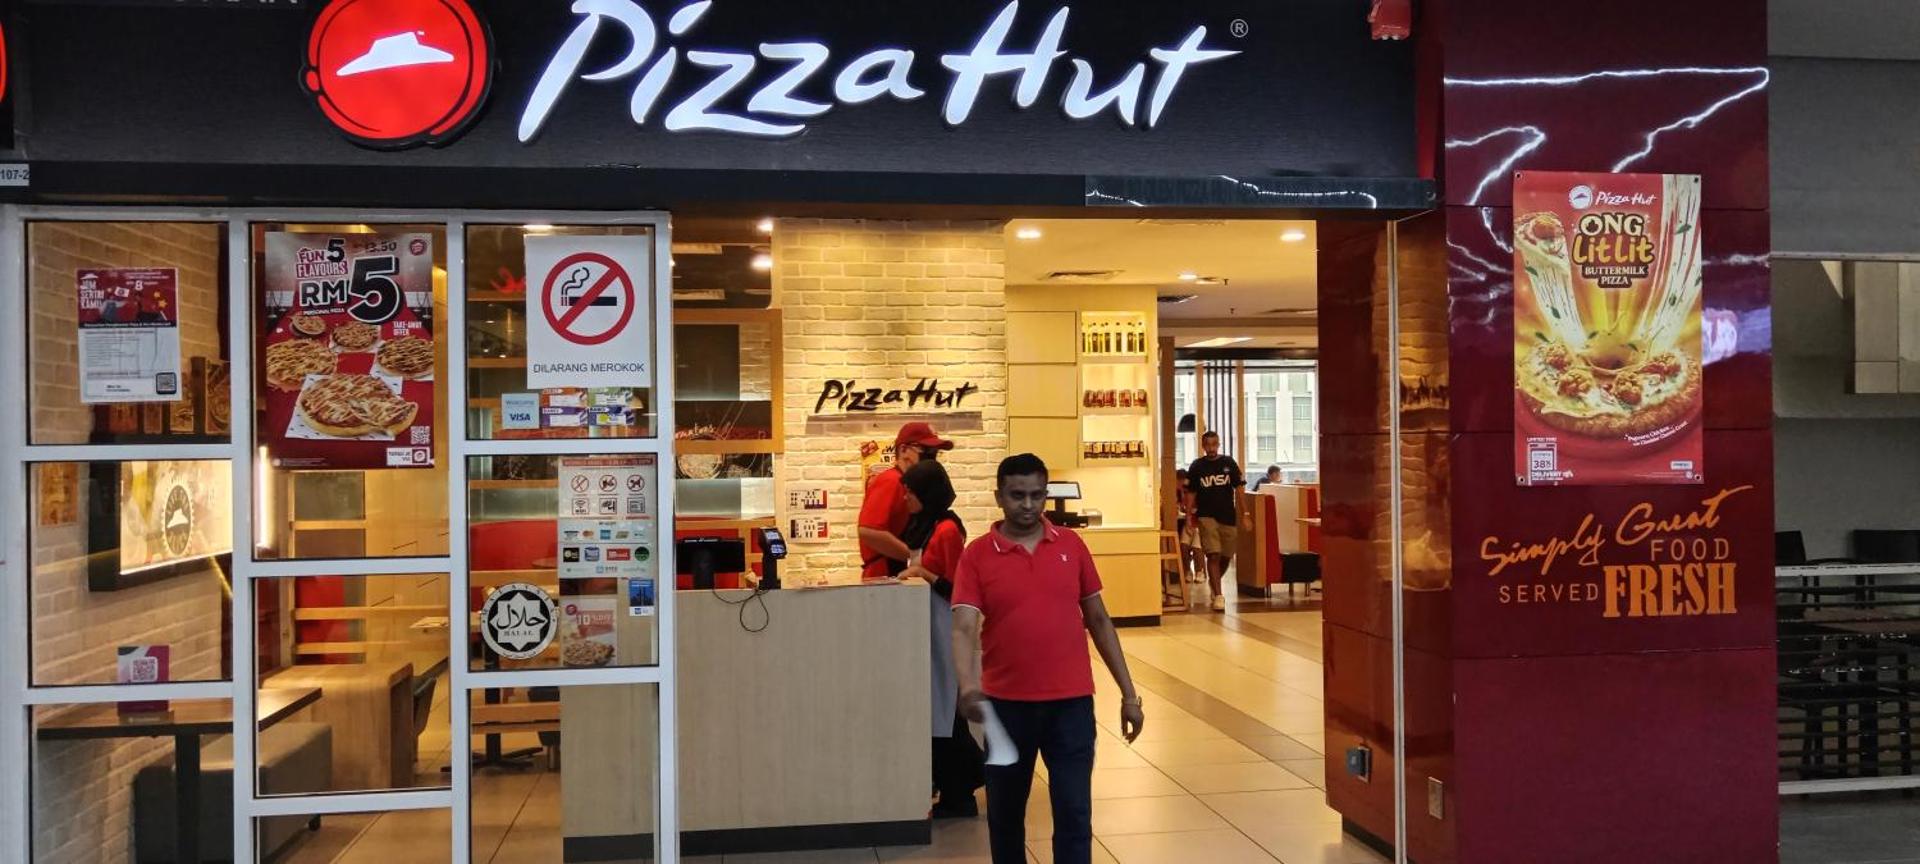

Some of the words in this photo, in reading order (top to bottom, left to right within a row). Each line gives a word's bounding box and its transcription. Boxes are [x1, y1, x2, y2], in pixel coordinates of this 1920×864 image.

[517, 0, 925, 143] Pizza
[941, 0, 1243, 128] Hut
[1595, 191, 1630, 206] Pizza
[1630, 192, 1657, 206] Hut
[1580, 213, 1644, 237] ONG
[299, 248, 326, 263] FUN
[327, 238, 346, 263] 5
[297, 261, 348, 277] FLAVOURS
[1585, 266, 1645, 275] BUTTERMILK
[1601, 275, 1629, 285] PIZZA
[533, 363, 588, 373] DILARANG
[590, 362, 645, 373] MEROKOK
[814, 379, 904, 413] Pizza
[908, 377, 978, 408] Hut
[509, 413, 531, 421] VISA
[1200, 474, 1231, 488] NASA
[1480, 513, 1606, 576] Simply
[1615, 485, 1753, 546] Great
[1650, 538, 1730, 561] FOOD
[1499, 583, 1599, 604] SERVED
[1603, 562, 1738, 618] FRESH
[497, 603, 545, 630] حلال
